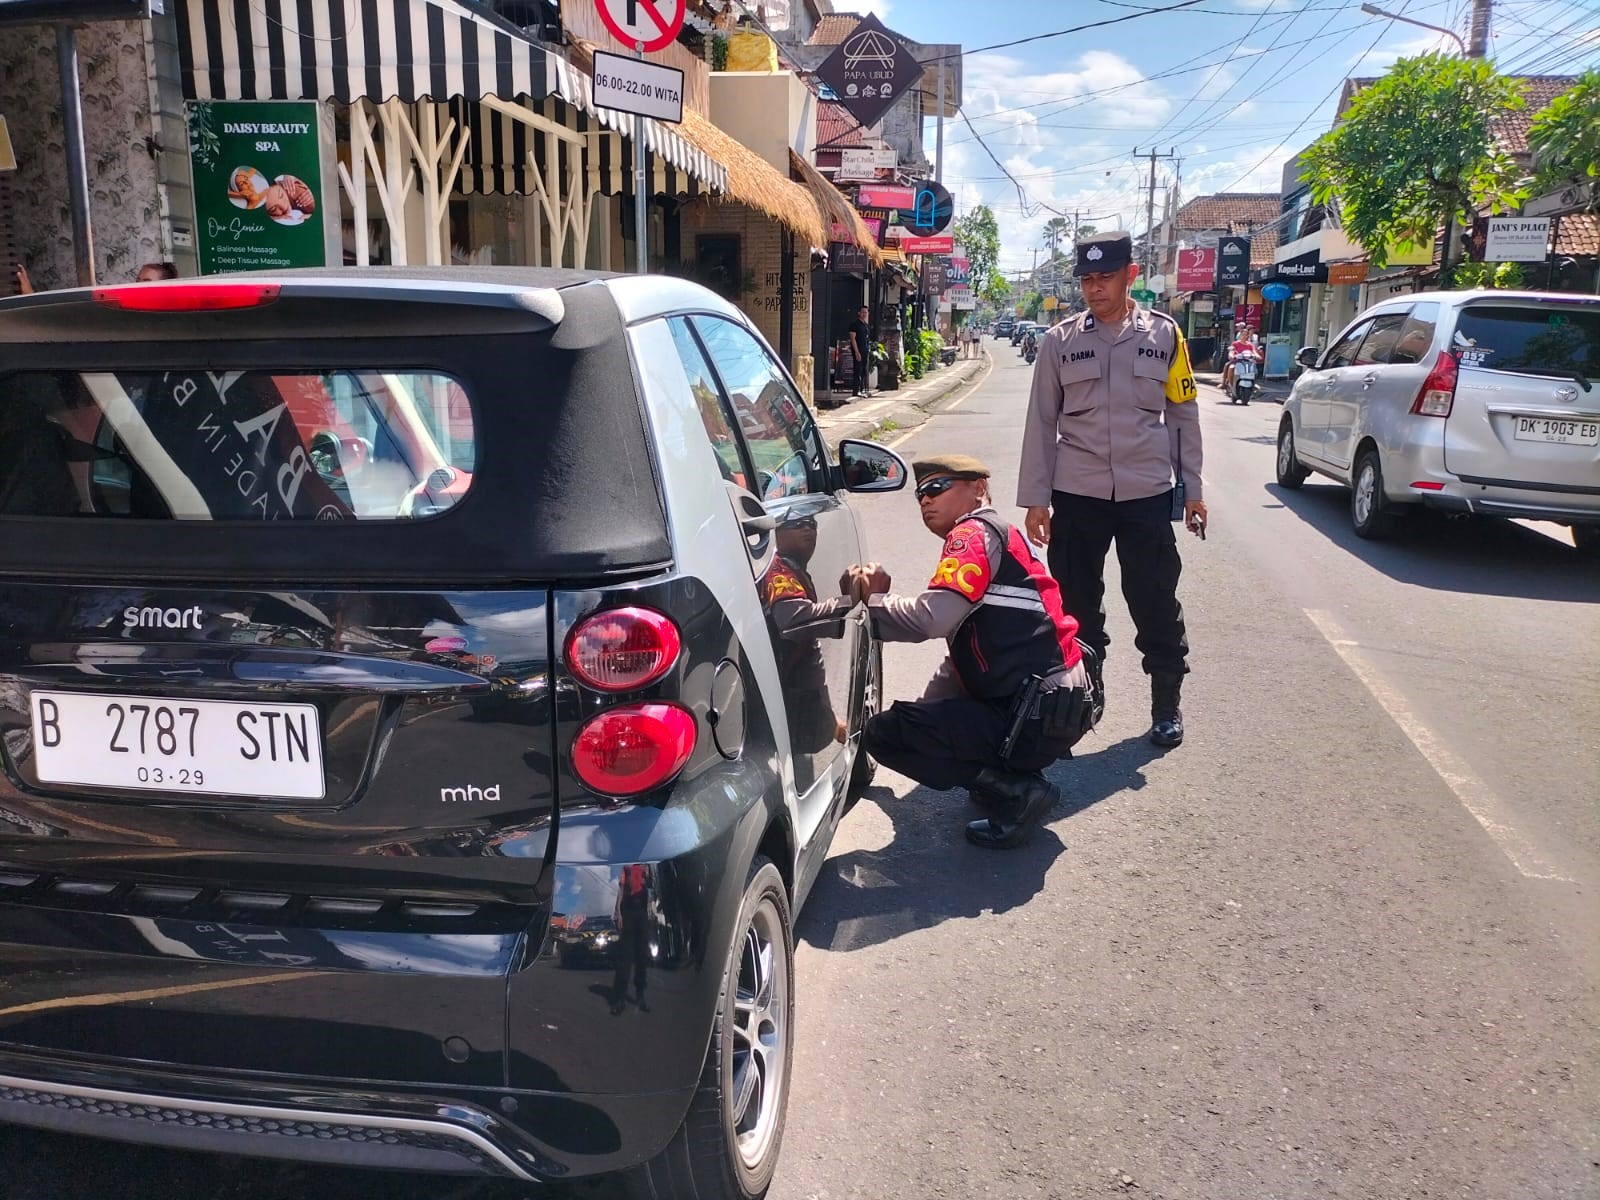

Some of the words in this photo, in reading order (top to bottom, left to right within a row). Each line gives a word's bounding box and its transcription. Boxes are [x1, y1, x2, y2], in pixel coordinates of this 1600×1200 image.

[844, 71, 866, 80] PAPA
[869, 71, 894, 80] UBUD
[595, 73, 652, 97] 06.00-22.00
[655, 86, 680, 103] WITA
[223, 123, 259, 134] DAISY
[261, 123, 310, 134] BEAUTY
[255, 141, 280, 152] SPA
[1491, 223, 1518, 233] JANI'S
[1520, 223, 1548, 232] PLACE
[216, 245, 246, 253] Balinese
[247, 246, 278, 255] Massage
[217, 256, 237, 265] Deep
[238, 257, 260, 265] Tissue
[260, 257, 291, 267] Massage
[945, 264, 965, 279] olk
[1062, 355, 1069, 364] P.
[1071, 350, 1095, 363] DARMA
[1138, 348, 1167, 361] POLRI
[1519, 419, 1536, 433] DK
[1542, 421, 1575, 436] 1903
[1580, 424, 1597, 438] EB
[123, 605, 203, 629] smart
[38, 699, 61, 748] B
[106, 703, 200, 758] 2787
[236, 711, 310, 764] STN
[440, 784, 500, 802] mhd
